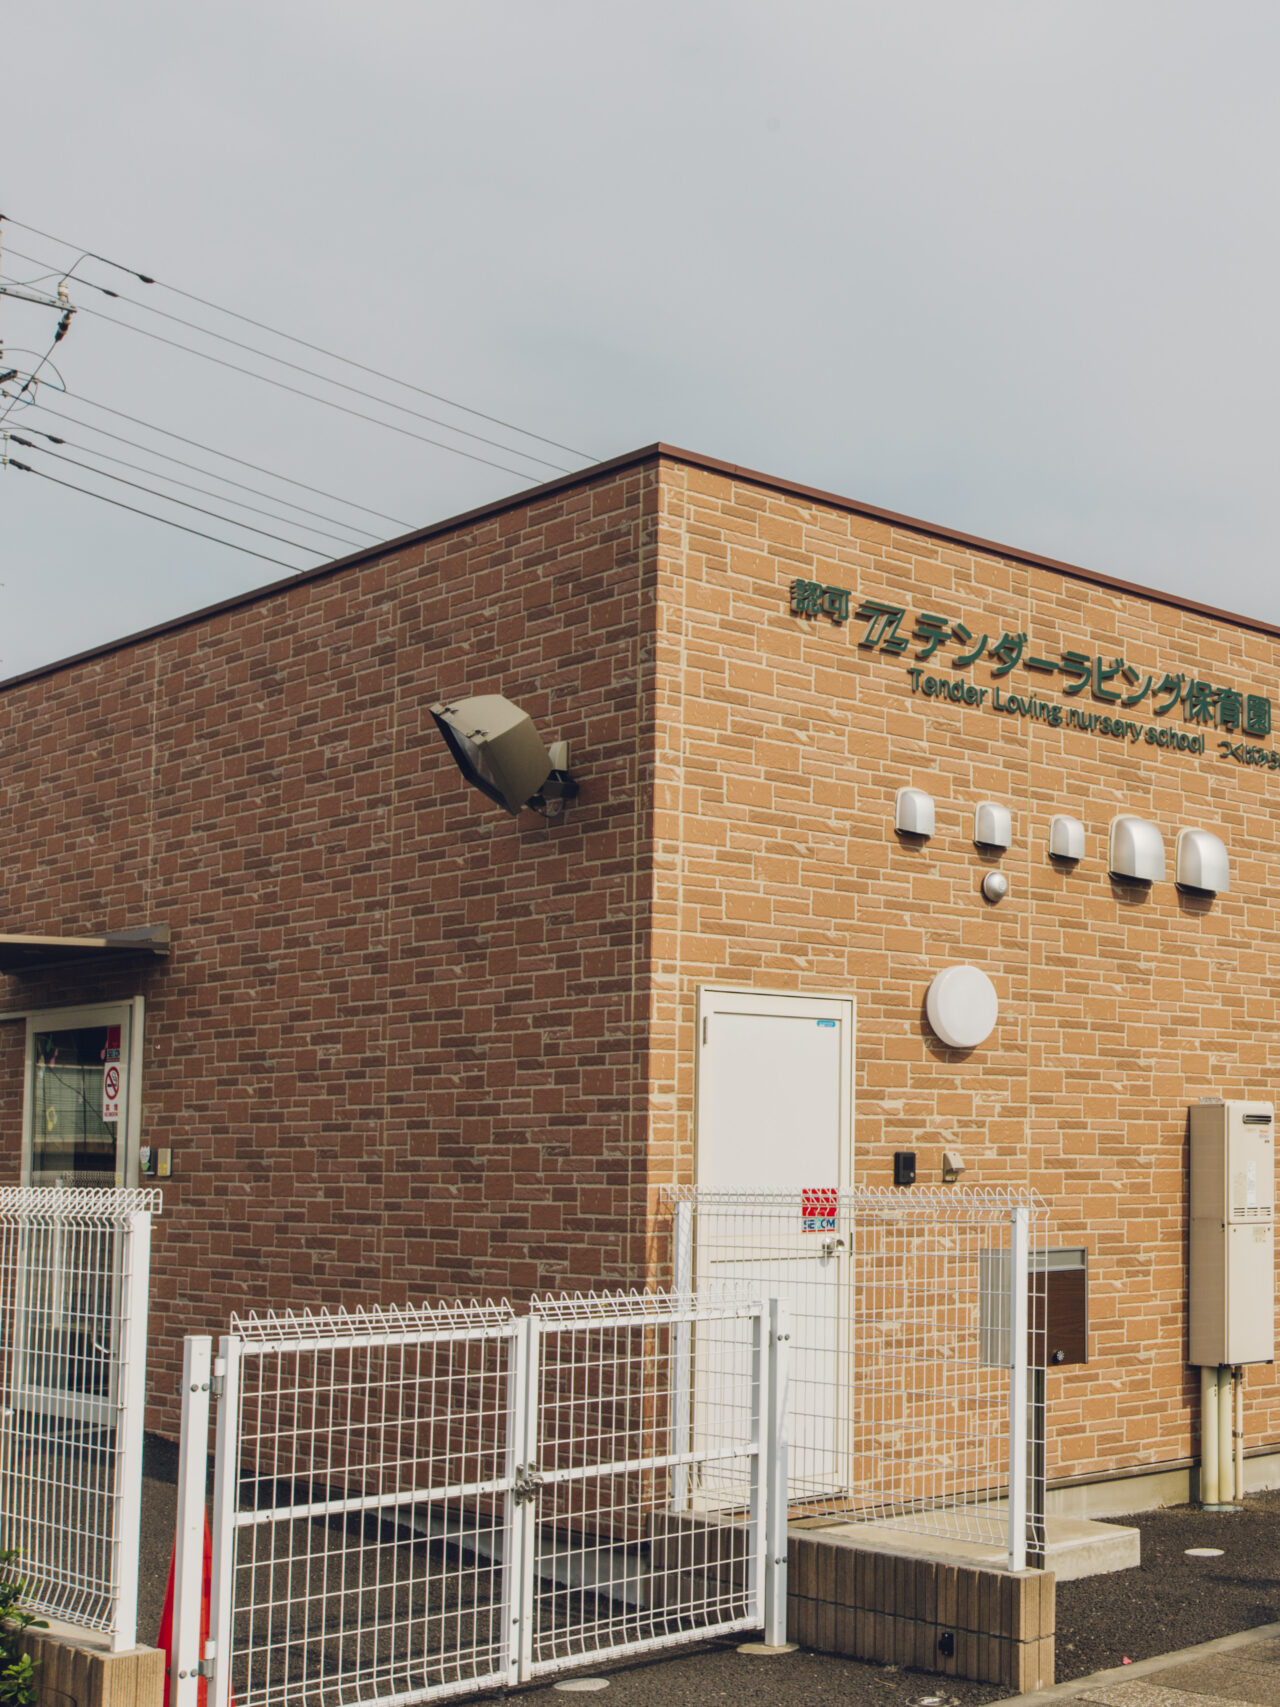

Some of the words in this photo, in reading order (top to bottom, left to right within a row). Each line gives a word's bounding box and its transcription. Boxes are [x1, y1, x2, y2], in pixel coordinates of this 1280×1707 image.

[791, 578, 851, 621] 認可
[913, 612, 1272, 736] テンダーラビング保育園
[907, 667, 988, 705] Tender
[992, 686, 1062, 725] Loving
[1067, 707, 1143, 743] nursery
[1145, 725, 1205, 754] school
